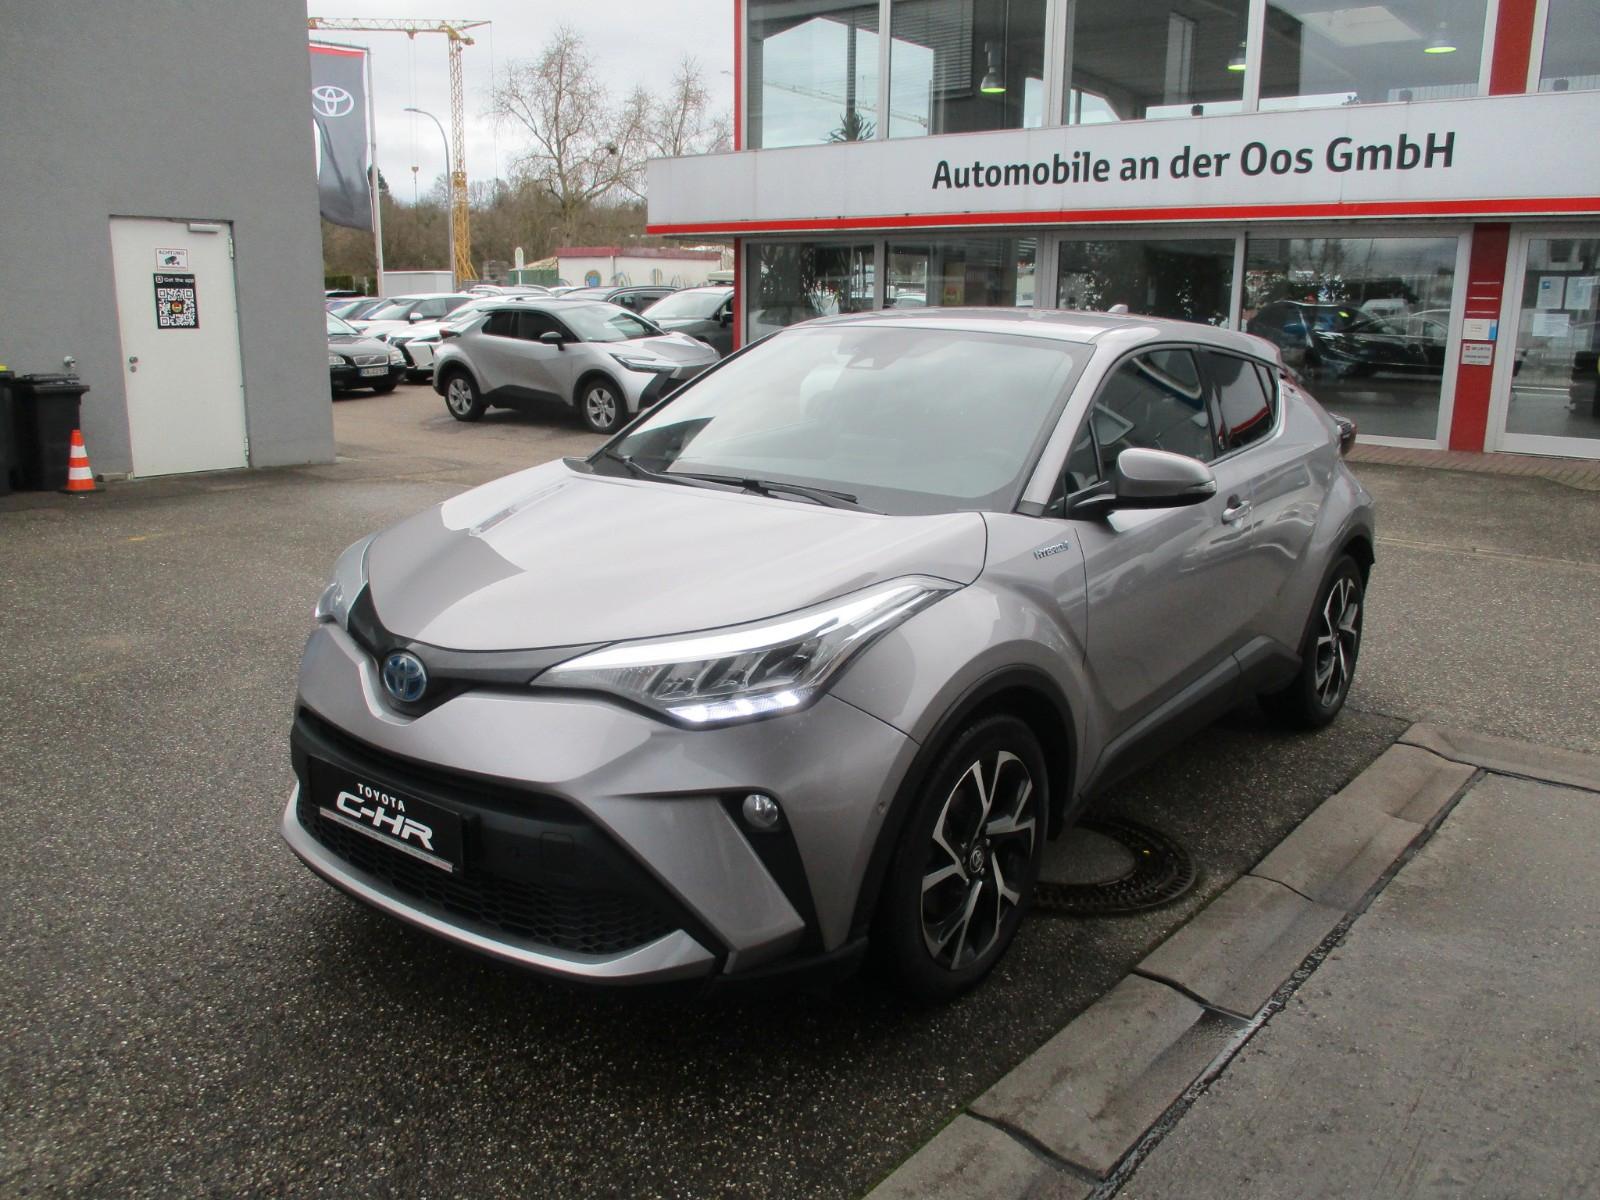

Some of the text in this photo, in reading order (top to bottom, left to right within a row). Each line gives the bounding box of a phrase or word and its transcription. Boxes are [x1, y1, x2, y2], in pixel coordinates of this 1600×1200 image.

[932, 132, 1456, 189] Automobile an der Oos GmbH
[336, 791, 434, 851] C-HR
[357, 783, 406, 812] TOYOTA
